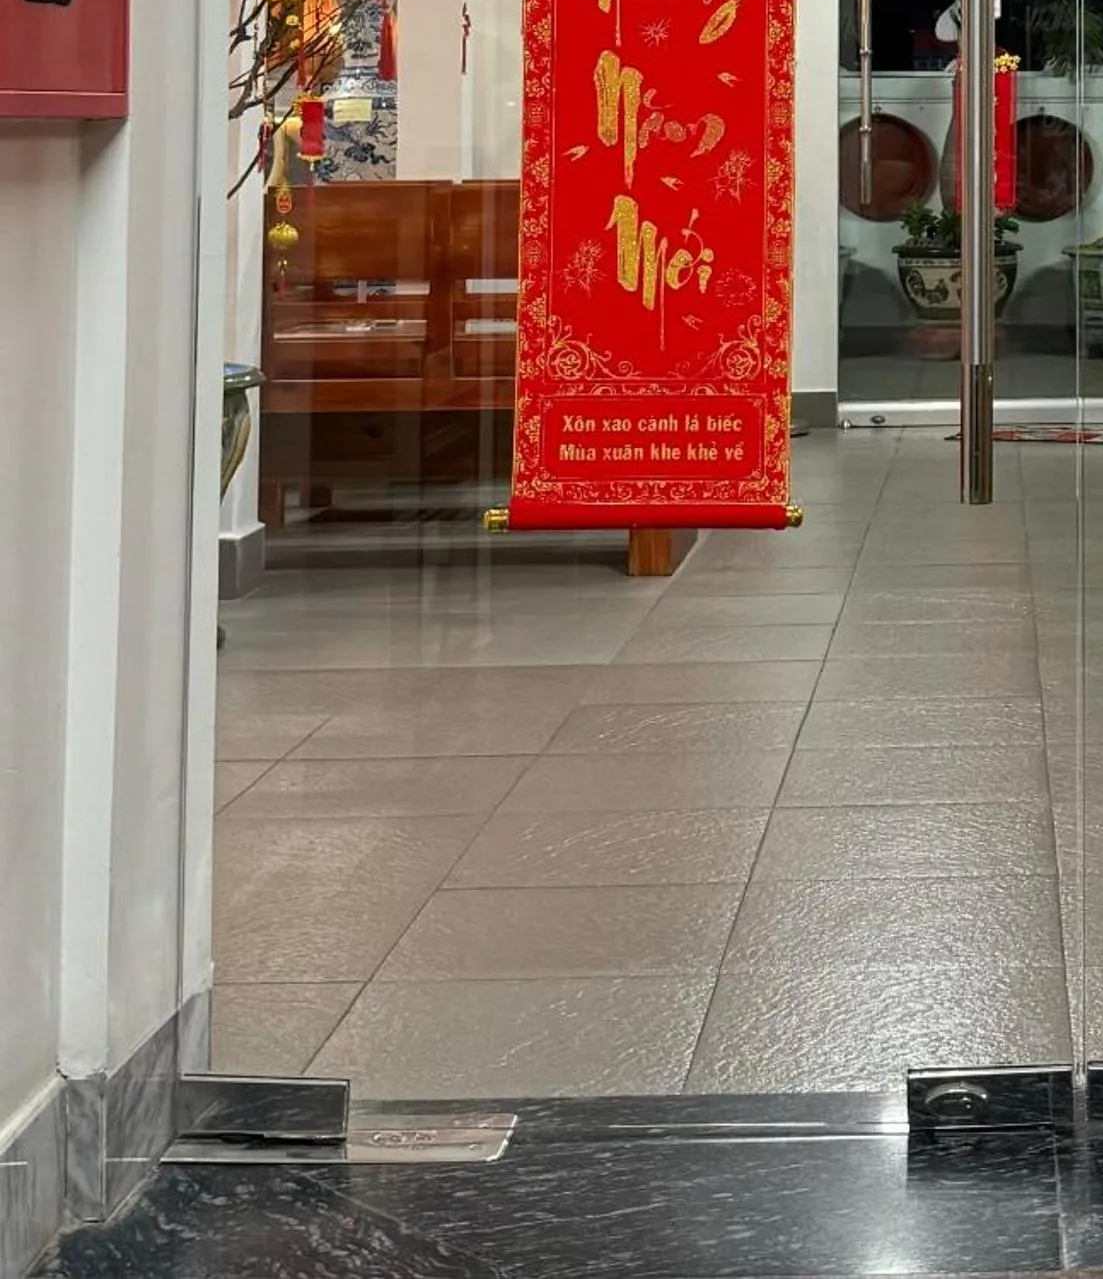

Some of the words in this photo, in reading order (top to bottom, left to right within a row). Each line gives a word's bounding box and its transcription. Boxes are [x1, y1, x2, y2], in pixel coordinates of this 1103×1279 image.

[593, 50, 725, 190] Năm
[604, 195, 714, 351] Mới
[559, 443, 597, 461] Mùa
[603, 444, 644, 461] xuân
[650, 442, 681, 460] khe
[562, 414, 596, 432] Xôn
[602, 418, 632, 432] xao
